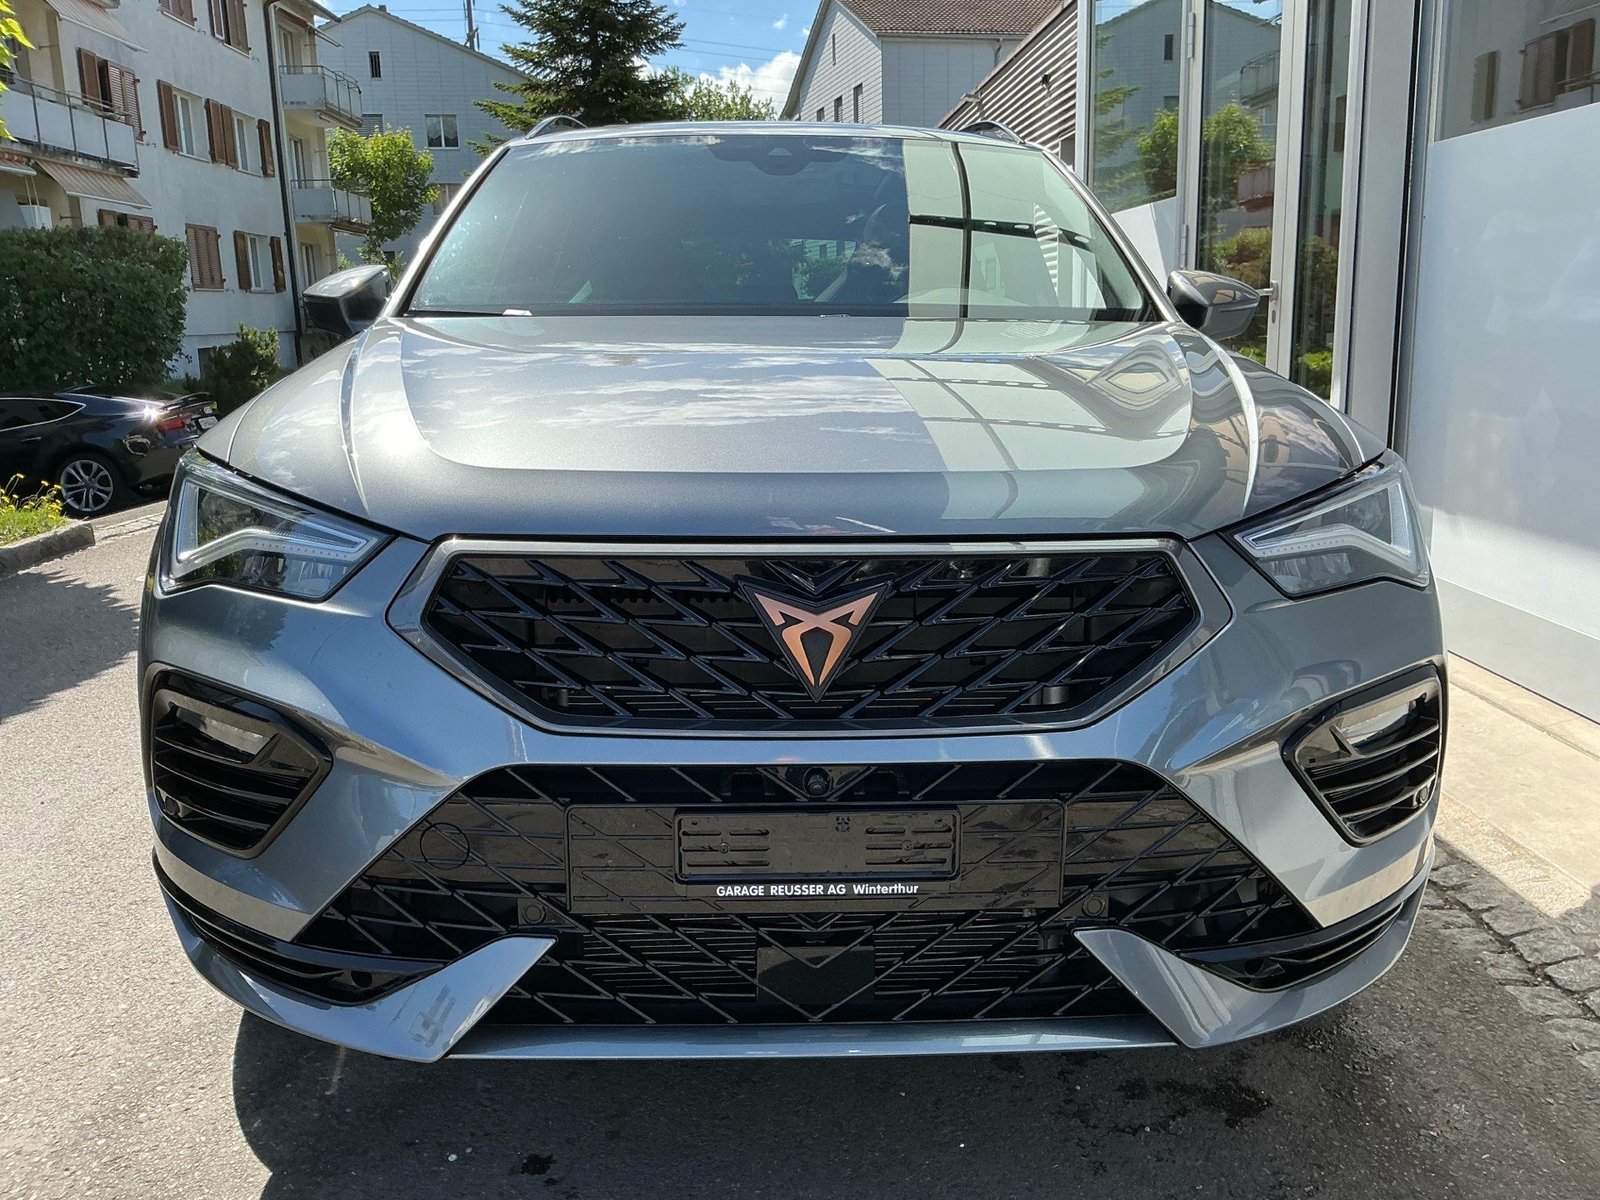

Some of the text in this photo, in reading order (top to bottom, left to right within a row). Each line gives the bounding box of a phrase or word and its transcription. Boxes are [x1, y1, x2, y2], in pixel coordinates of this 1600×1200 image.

[716, 883, 919, 897] GARAGE REUSSER AG Winterthur
